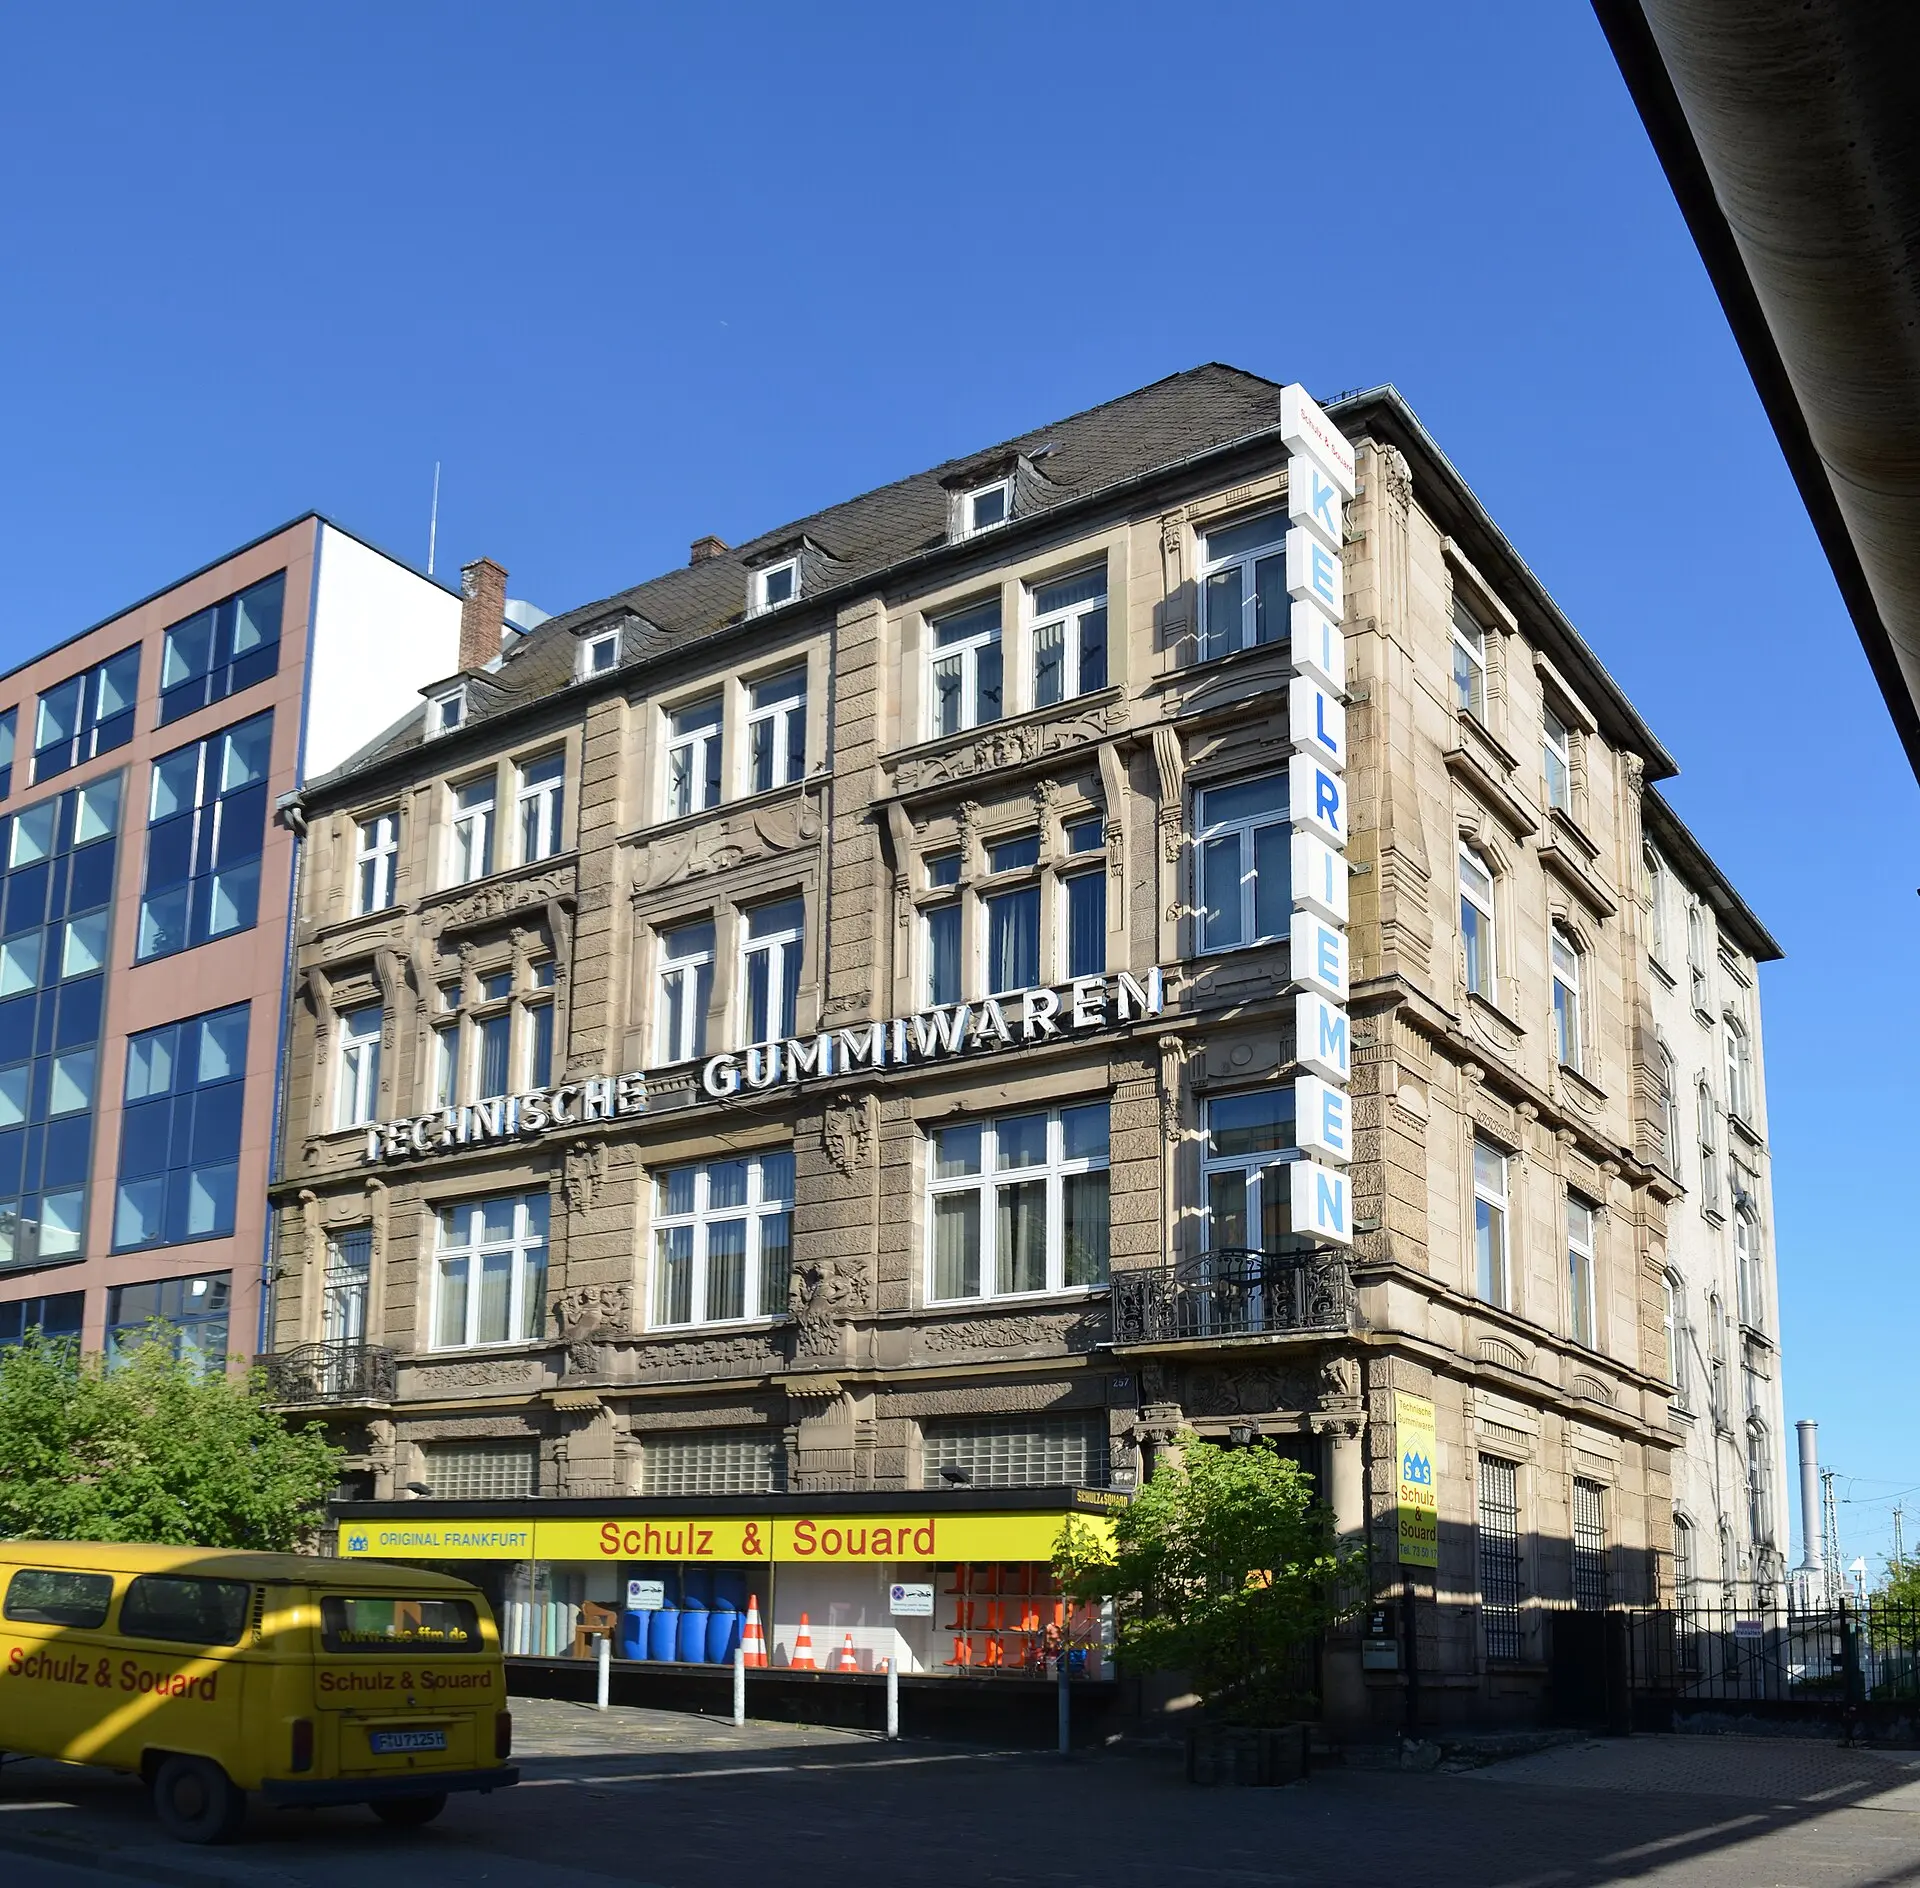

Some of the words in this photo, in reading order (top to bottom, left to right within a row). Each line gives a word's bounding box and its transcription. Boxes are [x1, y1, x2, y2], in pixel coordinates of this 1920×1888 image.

[1312, 469, 1346, 1234] KEILRIEMEN
[365, 1071, 647, 1163] TECHNISCHE
[703, 966, 1164, 1098] GUMMIWAREN
[1113, 1377, 1130, 1388] 257
[1399, 1399, 1432, 1418] Technische
[1397, 1413, 1435, 1433] Gummiwaren
[1401, 1484, 1435, 1507] Schulz
[1415, 1505, 1422, 1523] &
[380, 1532, 440, 1546] ORIGINAL
[444, 1533, 527, 1547] FRANKFURT
[599, 1522, 714, 1555] Schulz
[741, 1522, 764, 1556] &
[793, 1518, 936, 1556] Souard
[1400, 1520, 1436, 1542] Souard
[8, 1647, 90, 1686] Schulz
[94, 1657, 112, 1689] &
[119, 1660, 218, 1701] Souard
[320, 1671, 396, 1691] Schulz
[401, 1671, 415, 1690] &
[420, 1670, 492, 1690] Souard
